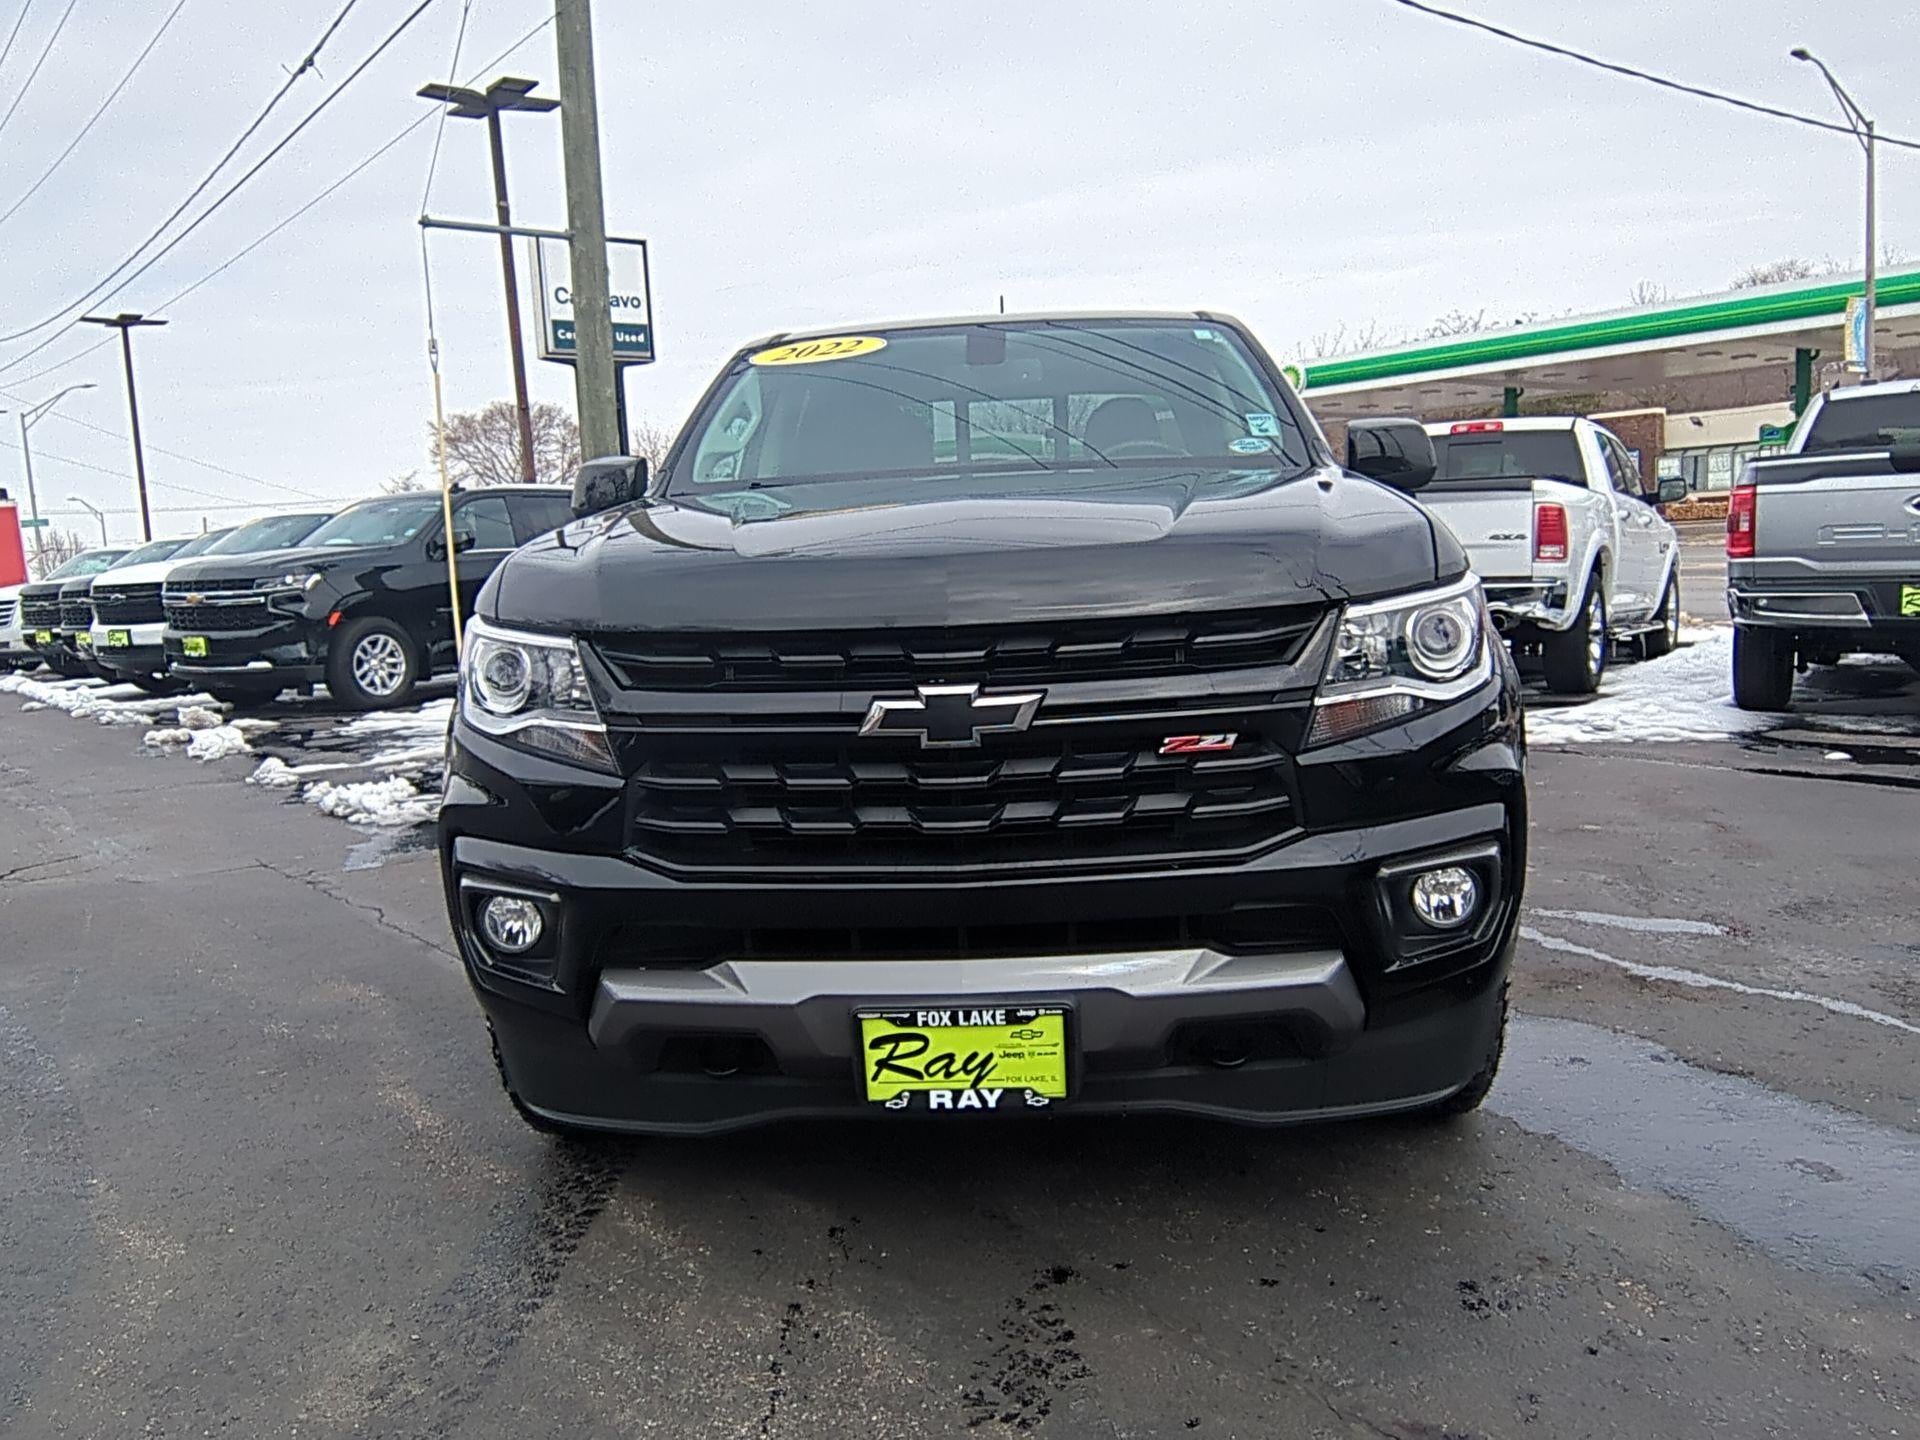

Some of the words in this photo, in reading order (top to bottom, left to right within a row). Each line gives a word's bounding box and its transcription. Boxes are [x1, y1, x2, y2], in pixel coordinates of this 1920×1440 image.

[615, 331, 645, 342] Used
[770, 339, 864, 361] 2022
[917, 1010, 952, 1027] FOX
[958, 1009, 1007, 1026] LAKE
[868, 1032, 998, 1088] Ray
[999, 1050, 1025, 1060] Jeep
[1006, 1075, 1023, 1083] FOX
[929, 1088, 1004, 1110] RAY
